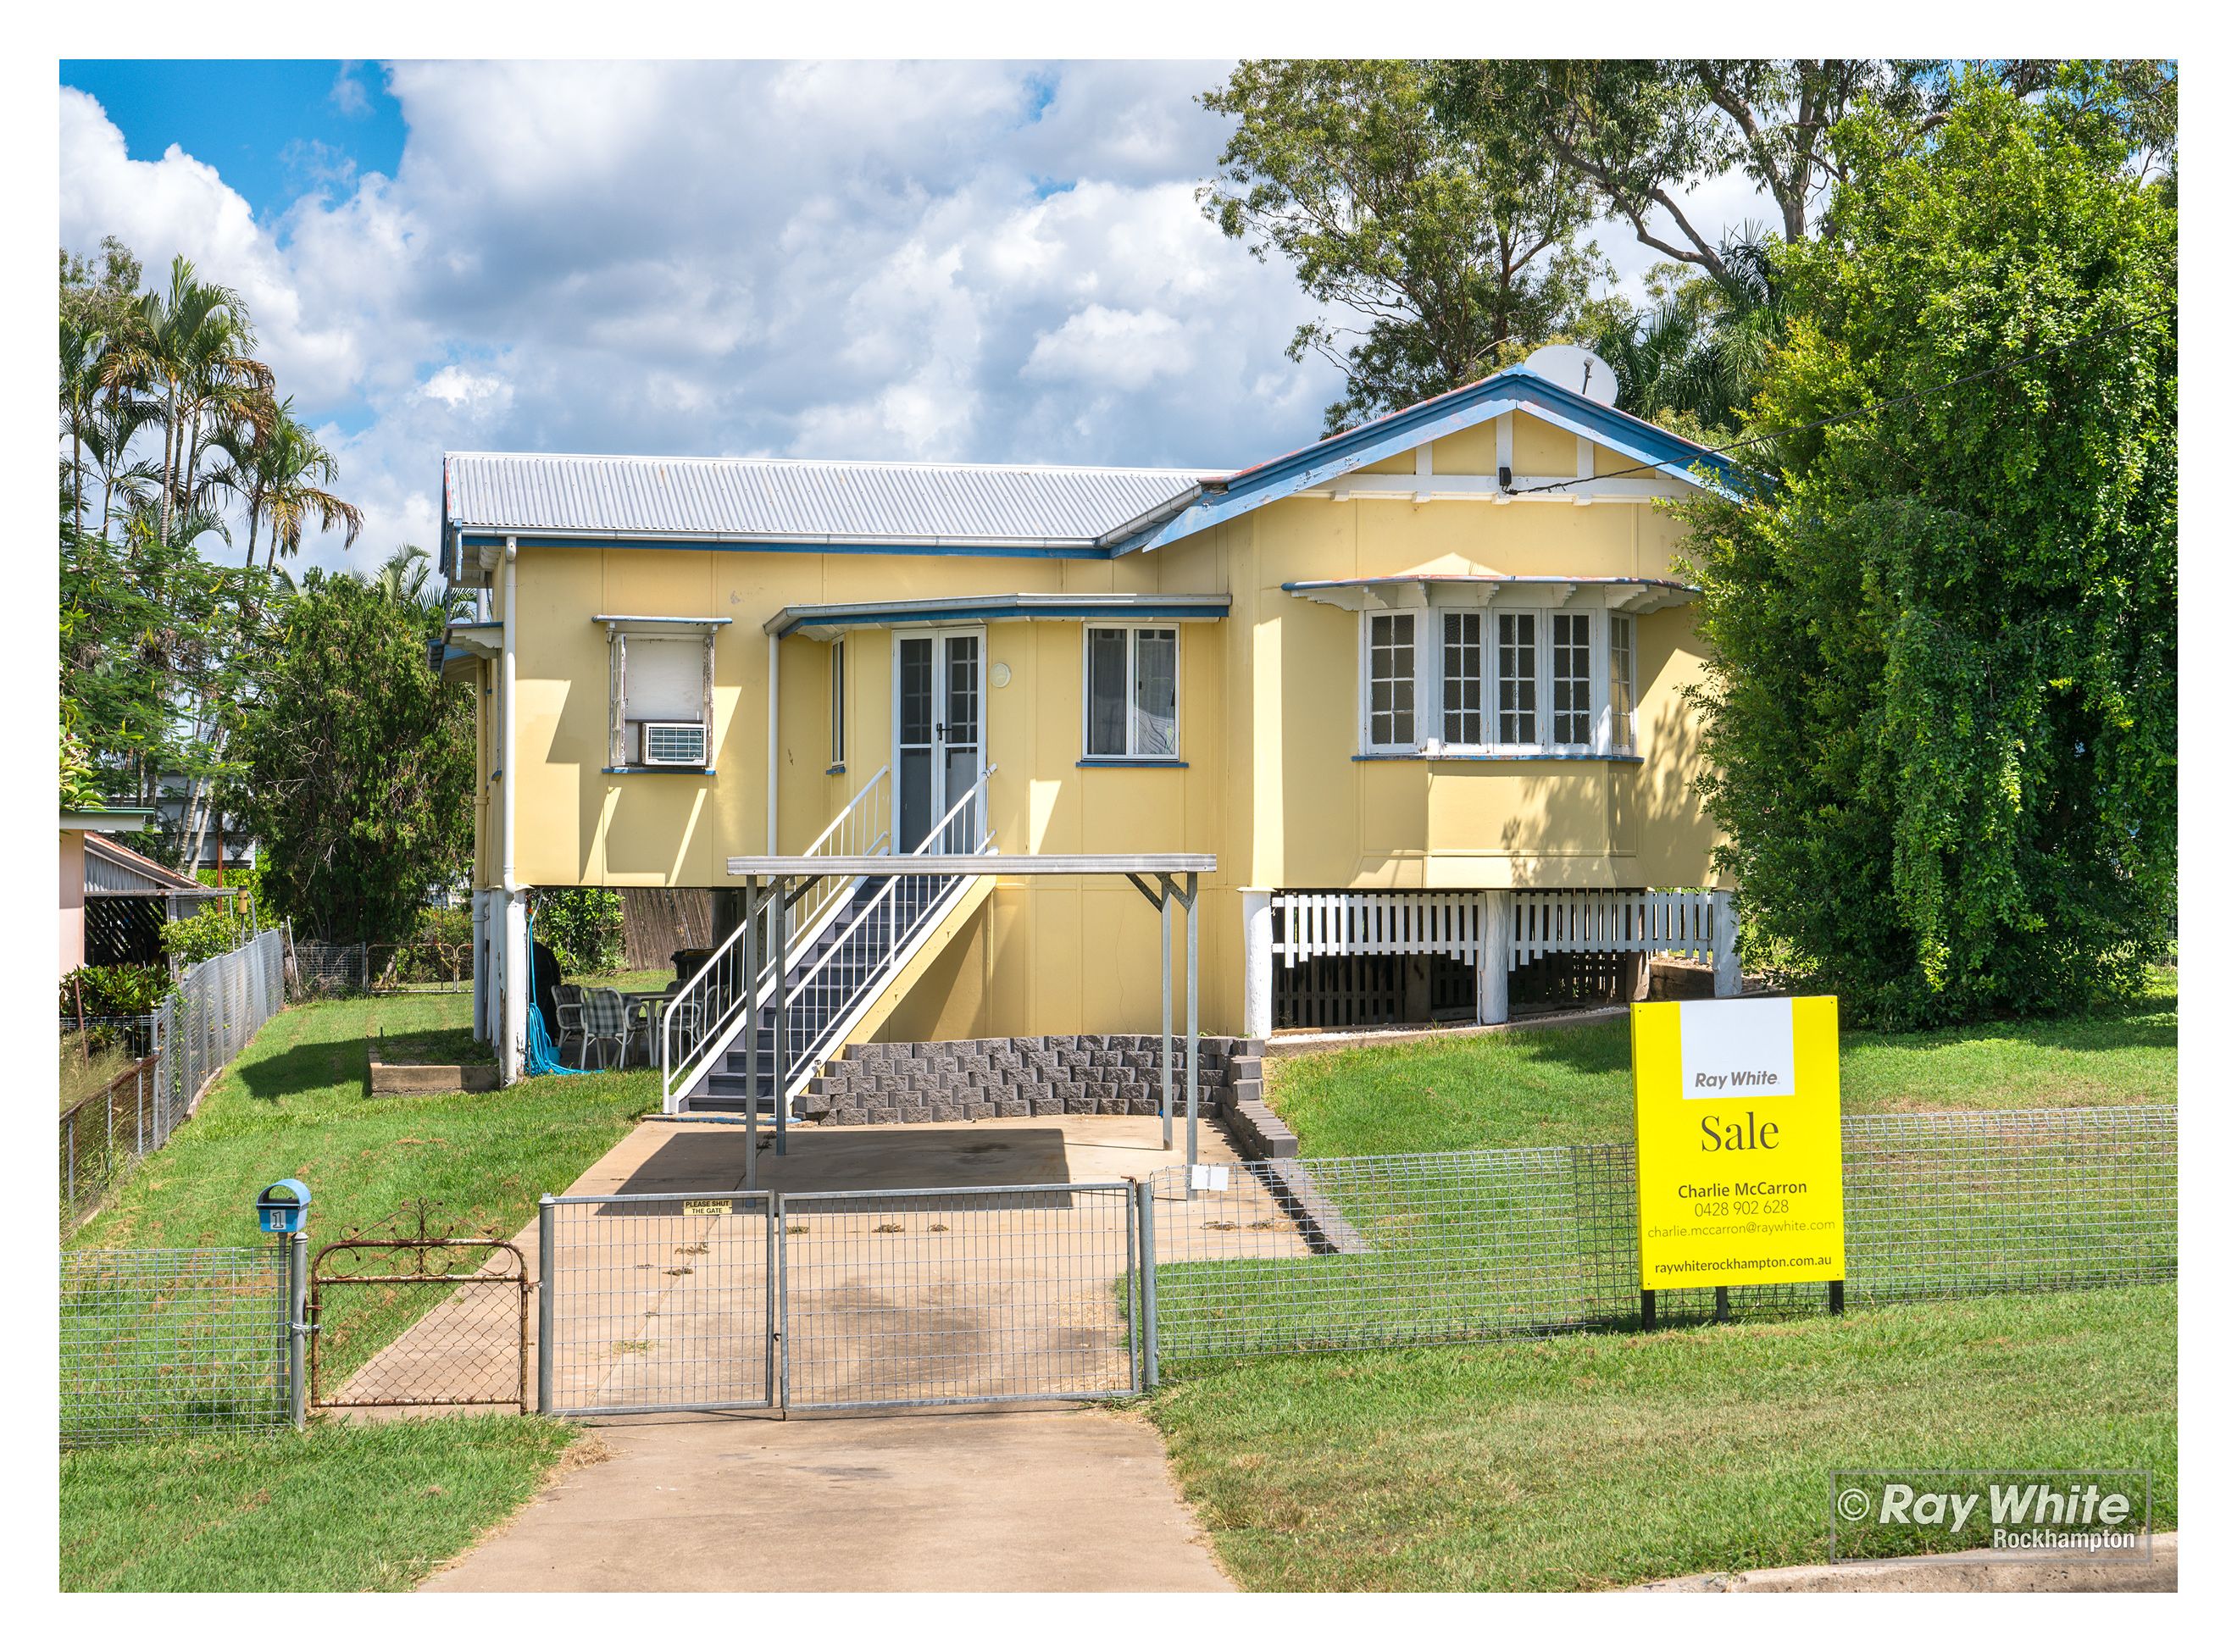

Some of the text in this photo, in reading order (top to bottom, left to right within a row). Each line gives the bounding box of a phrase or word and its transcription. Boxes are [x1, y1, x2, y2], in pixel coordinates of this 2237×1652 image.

[1695, 1071, 1778, 1089] Ray White
[1701, 1111, 1779, 1152] Sale
[1678, 1182, 1807, 1199] Charlie McCarron
[1694, 1200, 1789, 1217] 0428 902 628
[272, 1211, 284, 1228] 1
[1647, 1219, 1835, 1239] charlie.mccarron@raywhite.com
[1654, 1256, 1832, 1274] raywhiterockhampton.com.au
